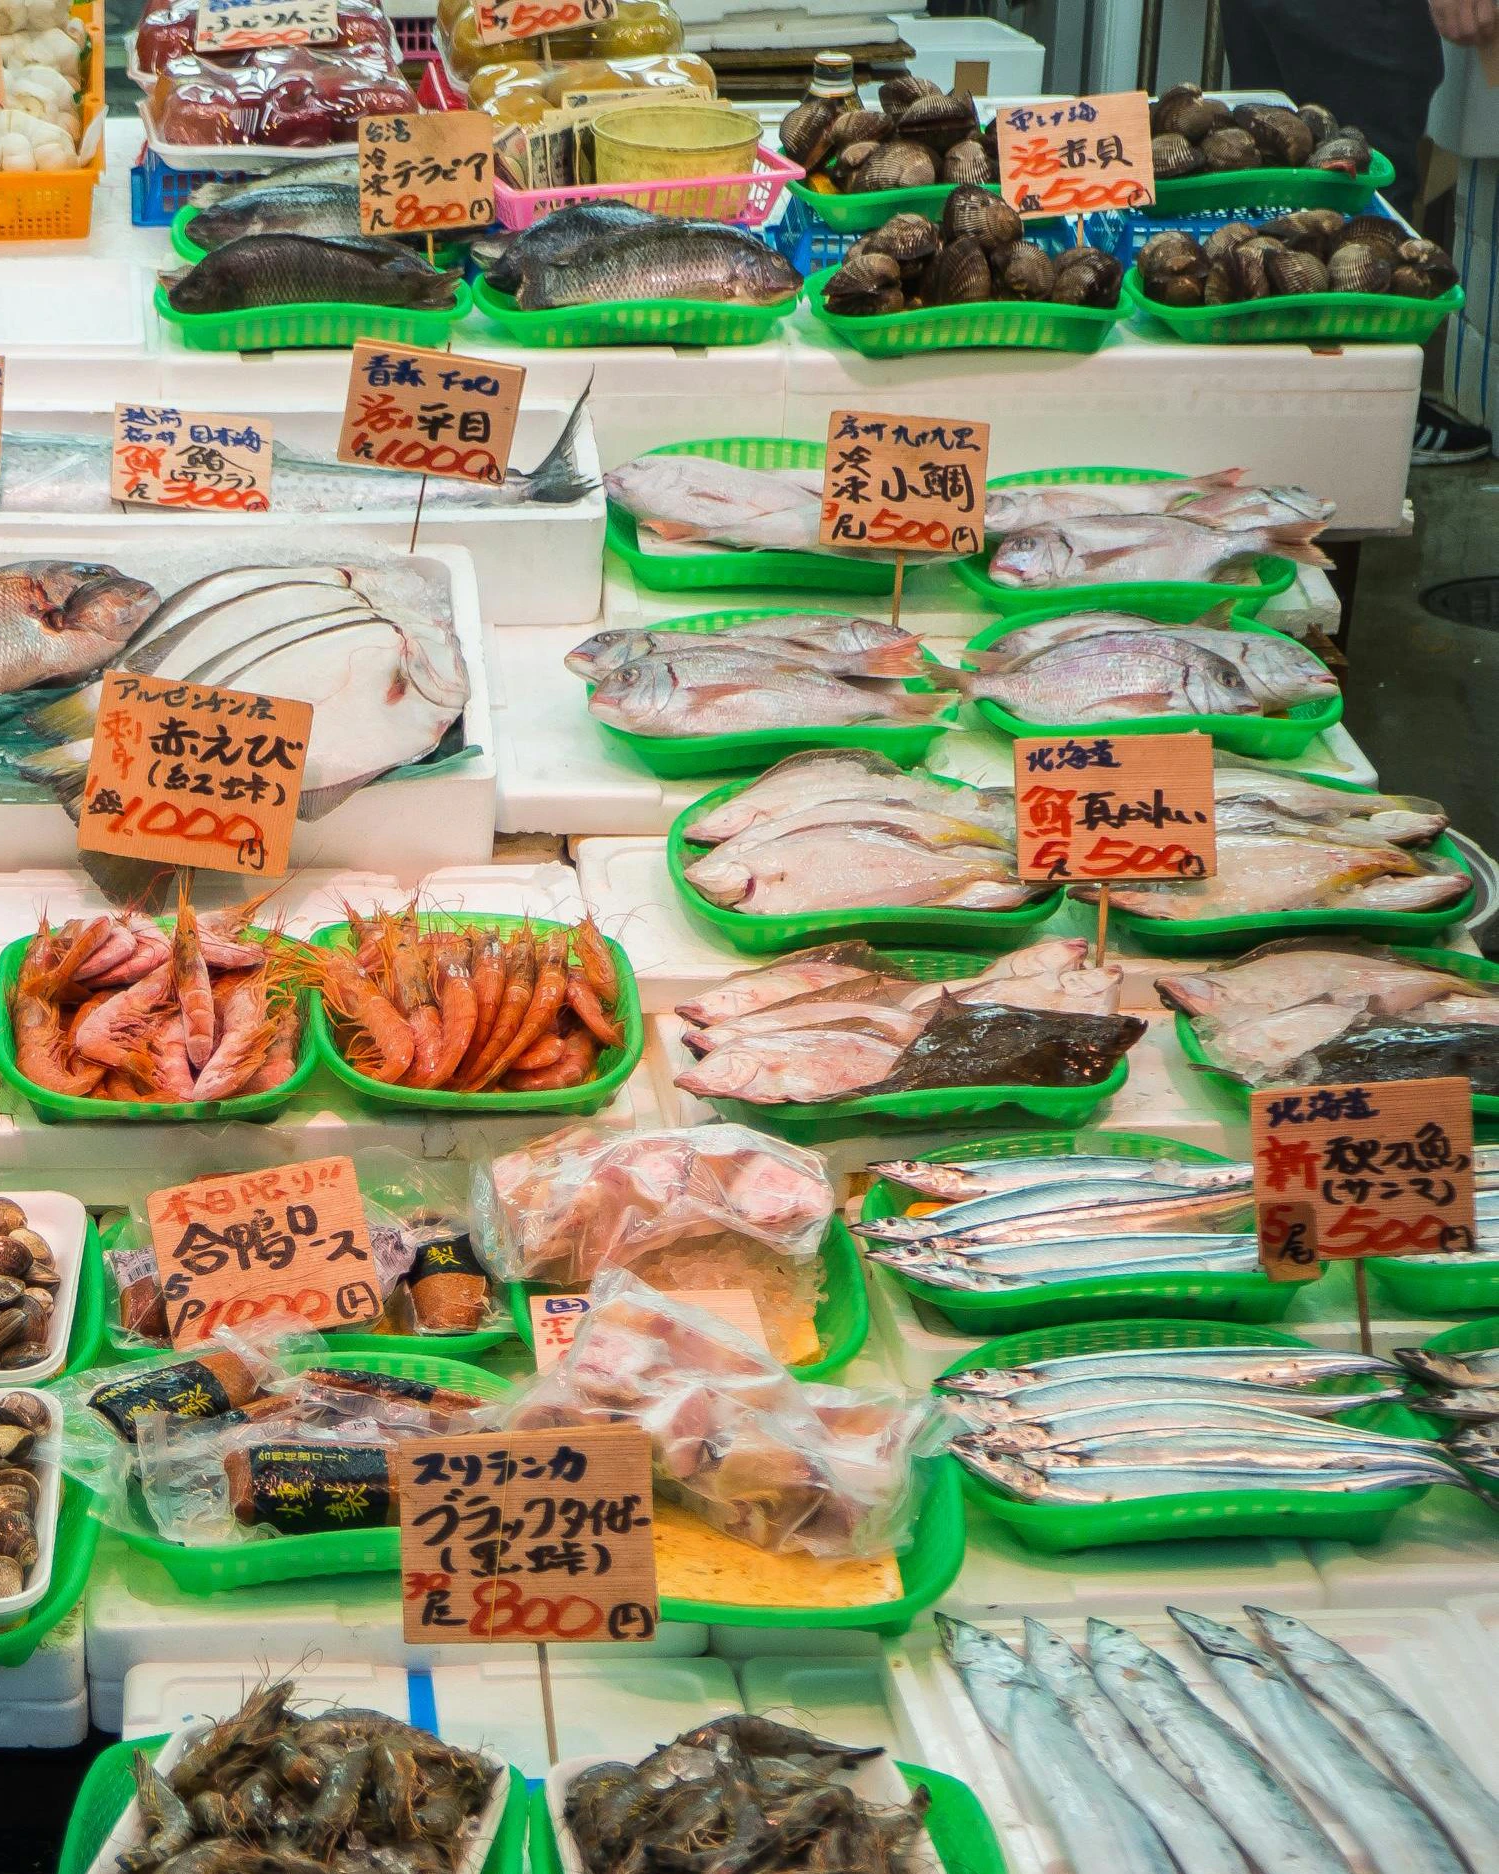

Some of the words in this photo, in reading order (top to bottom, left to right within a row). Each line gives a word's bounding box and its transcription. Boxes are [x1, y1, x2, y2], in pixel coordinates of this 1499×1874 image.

[392, 152, 488, 188] テラピア
[362, 354, 426, 388] 青森
[881, 462, 975, 512] 小鯛
[148, 716, 304, 770] 赤えび
[1026, 740, 1123, 772] 北海道
[1268, 1087, 1380, 1128] 北海道
[160, 1164, 341, 1226] 本日限り!!
[1322, 1178, 1459, 1207] (サンマ)
[173, 1205, 368, 1275] 合鴨ロース
[413, 1445, 588, 1485] スリランカ
